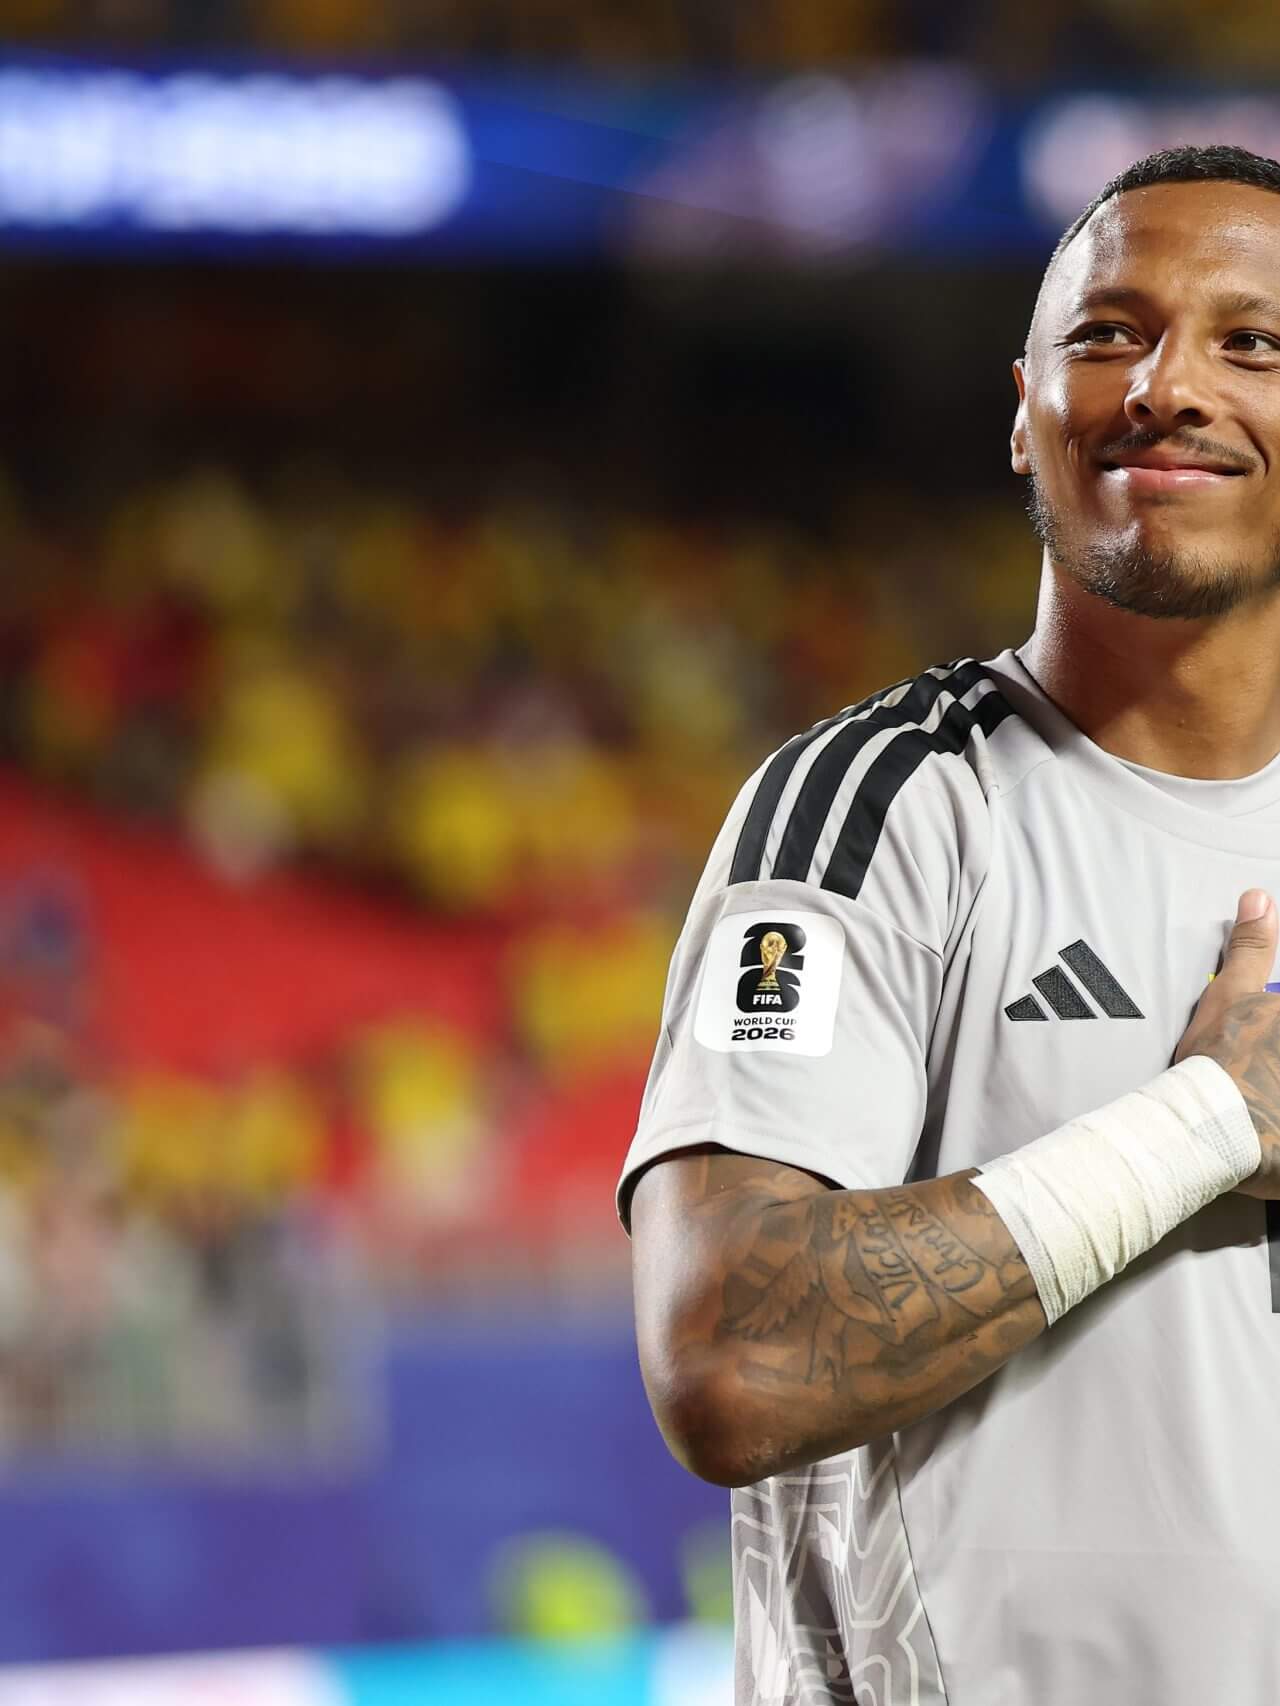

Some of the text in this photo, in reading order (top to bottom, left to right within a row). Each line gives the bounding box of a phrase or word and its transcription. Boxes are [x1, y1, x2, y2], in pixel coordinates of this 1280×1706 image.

[752, 994, 783, 1006] FIFA
[734, 1016, 797, 1026] WORLD CUP
[731, 1027, 796, 1041] 2026
